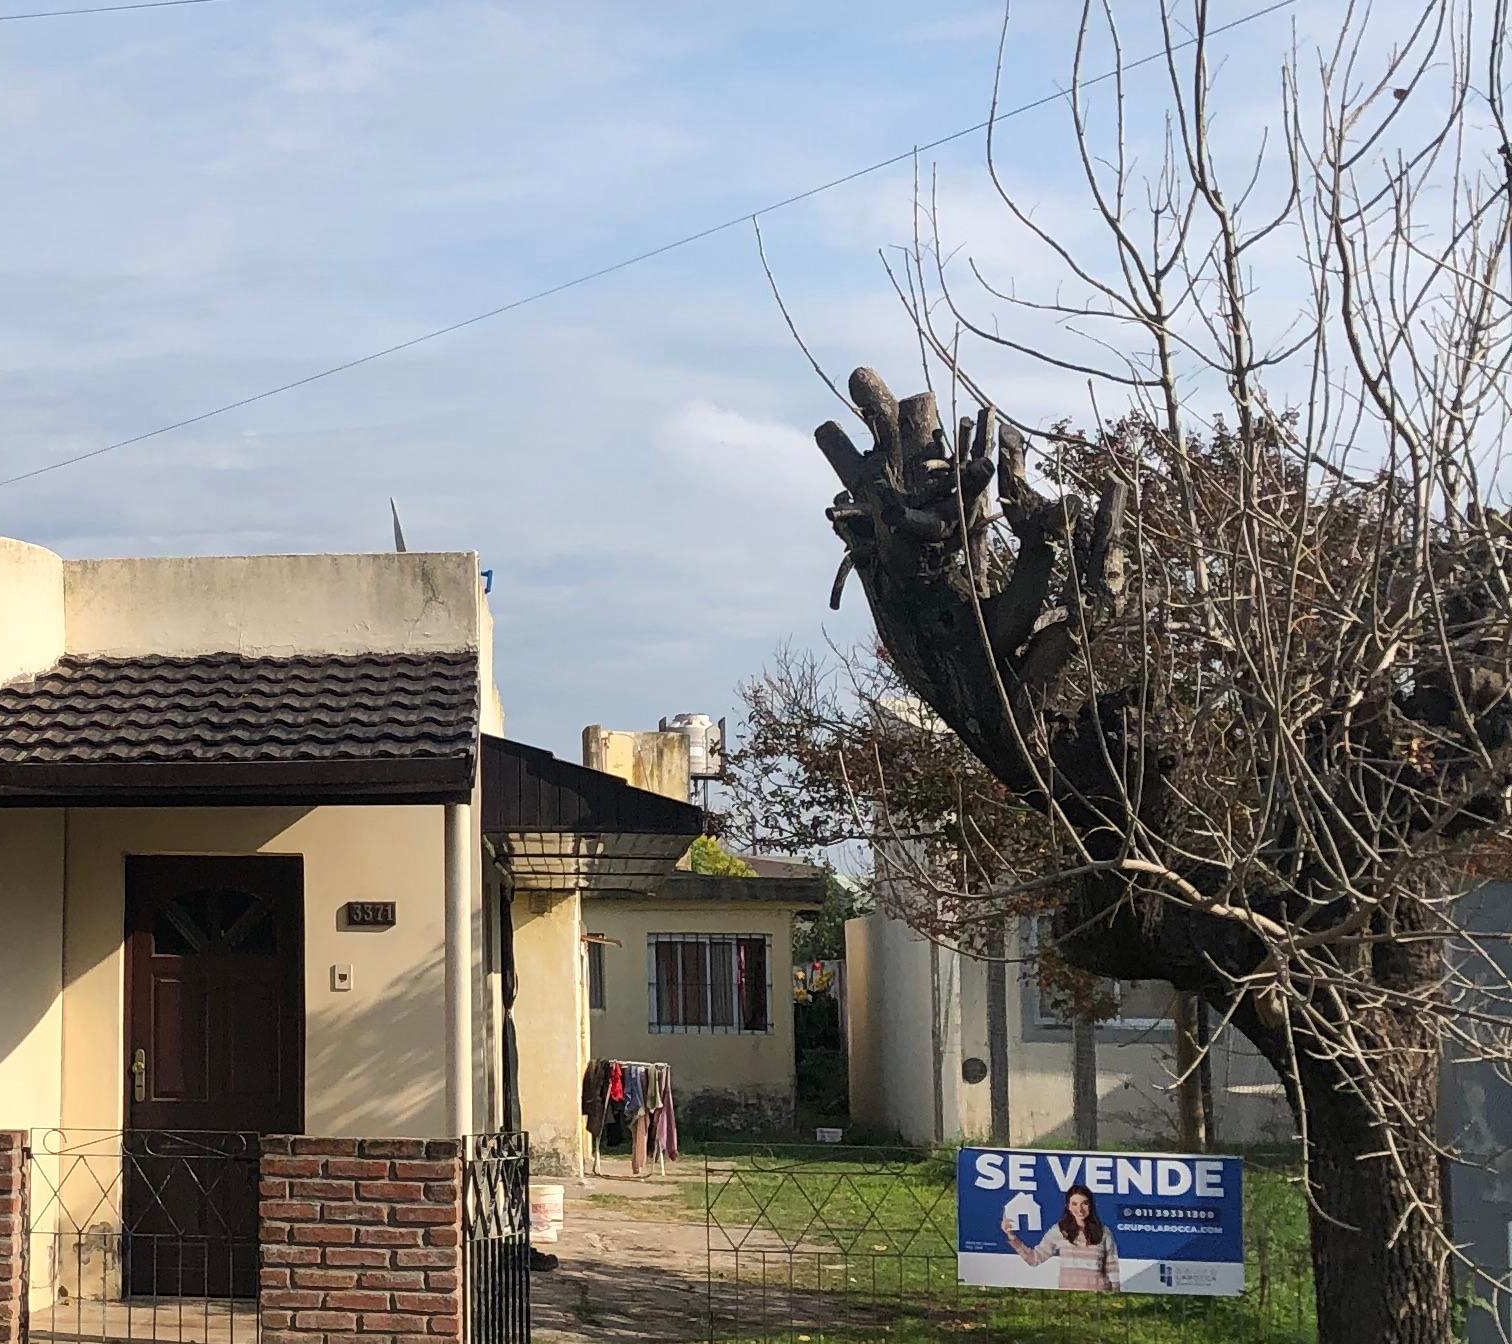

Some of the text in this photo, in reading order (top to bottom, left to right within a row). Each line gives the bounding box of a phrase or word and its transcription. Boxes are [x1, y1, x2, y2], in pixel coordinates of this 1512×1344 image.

[353, 904, 393, 921] 3371
[974, 1153, 1225, 1198] SE VENDE
[1135, 1208, 1153, 1217] 011
[1117, 1223, 1223, 1234] GRUPOLAROCCA.COM
